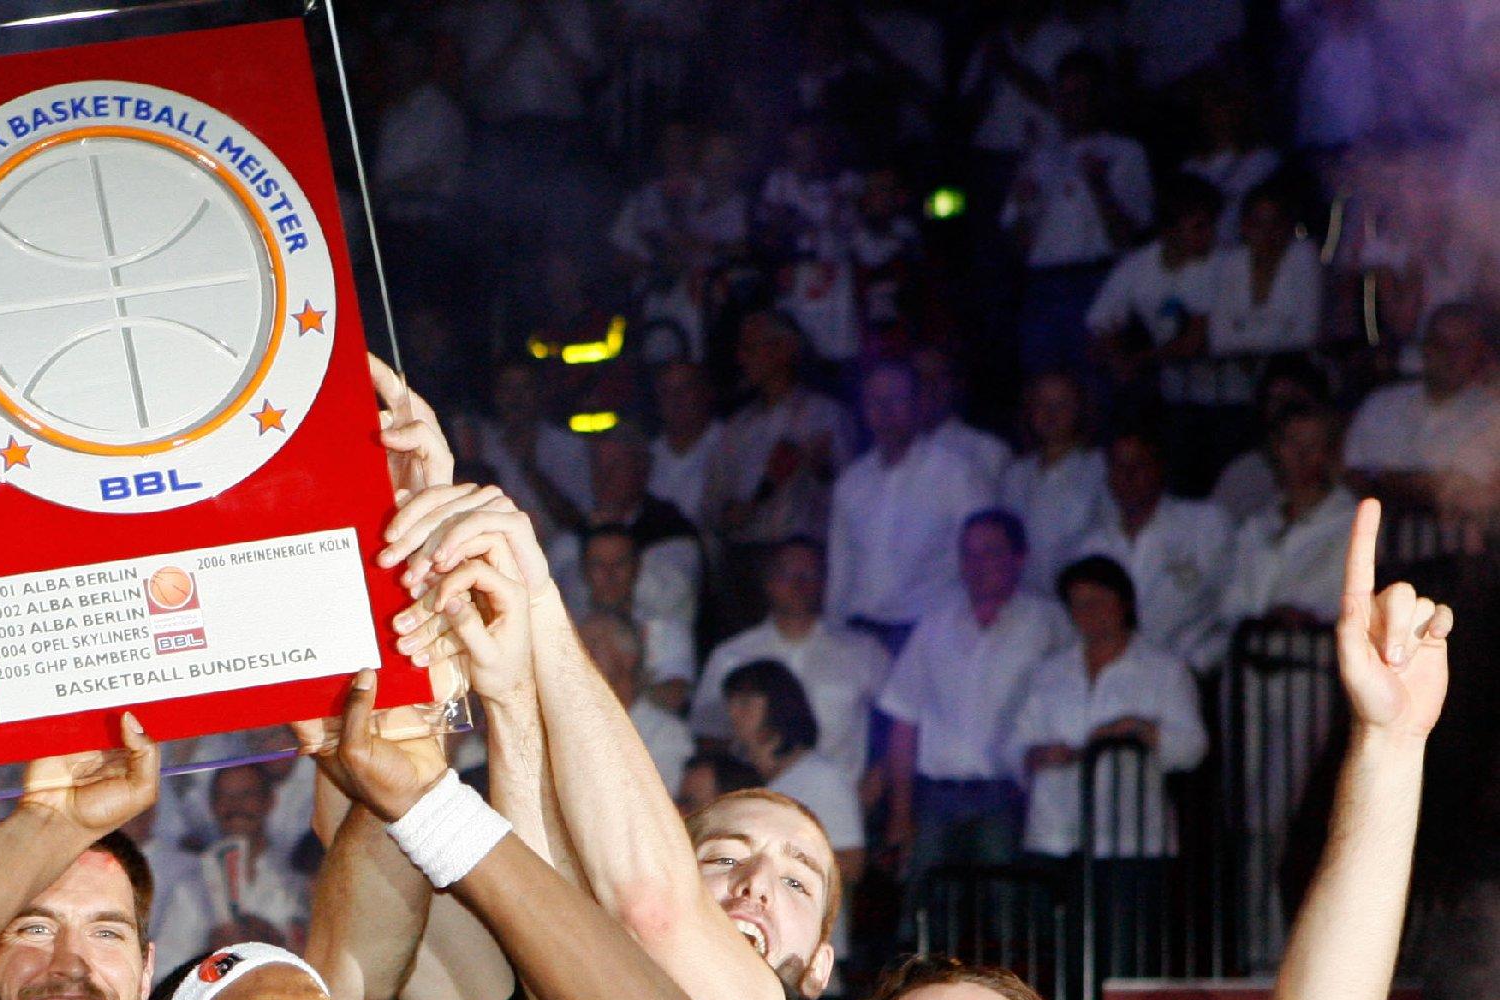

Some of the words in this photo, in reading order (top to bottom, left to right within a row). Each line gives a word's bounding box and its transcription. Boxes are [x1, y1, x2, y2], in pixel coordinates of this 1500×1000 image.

[7, 95, 209, 146] BASKETBALL
[215, 135, 308, 256] MEISTER
[99, 468, 201, 501] BBL
[197, 555, 226, 570] 2006
[230, 541, 315, 565] RHEINENERGIE
[319, 537, 350, 552] KÖLN
[23, 577, 70, 595] ALBA
[75, 567, 138, 588] BERLIN
[27, 597, 74, 614] ALBA
[79, 587, 141, 608] BERLIN
[30, 617, 78, 635] ALBA
[83, 607, 145, 627] BERLIN
[32, 638, 69, 654] OPEL
[72, 625, 149, 649] SKYLINERS
[159, 634, 203, 650] BBL
[35, 659, 68, 674] GHP
[73, 647, 151, 670] BAMBERG
[55, 667, 183, 697] BASKETBALL
[189, 648, 317, 678] BUNDESLIGA
